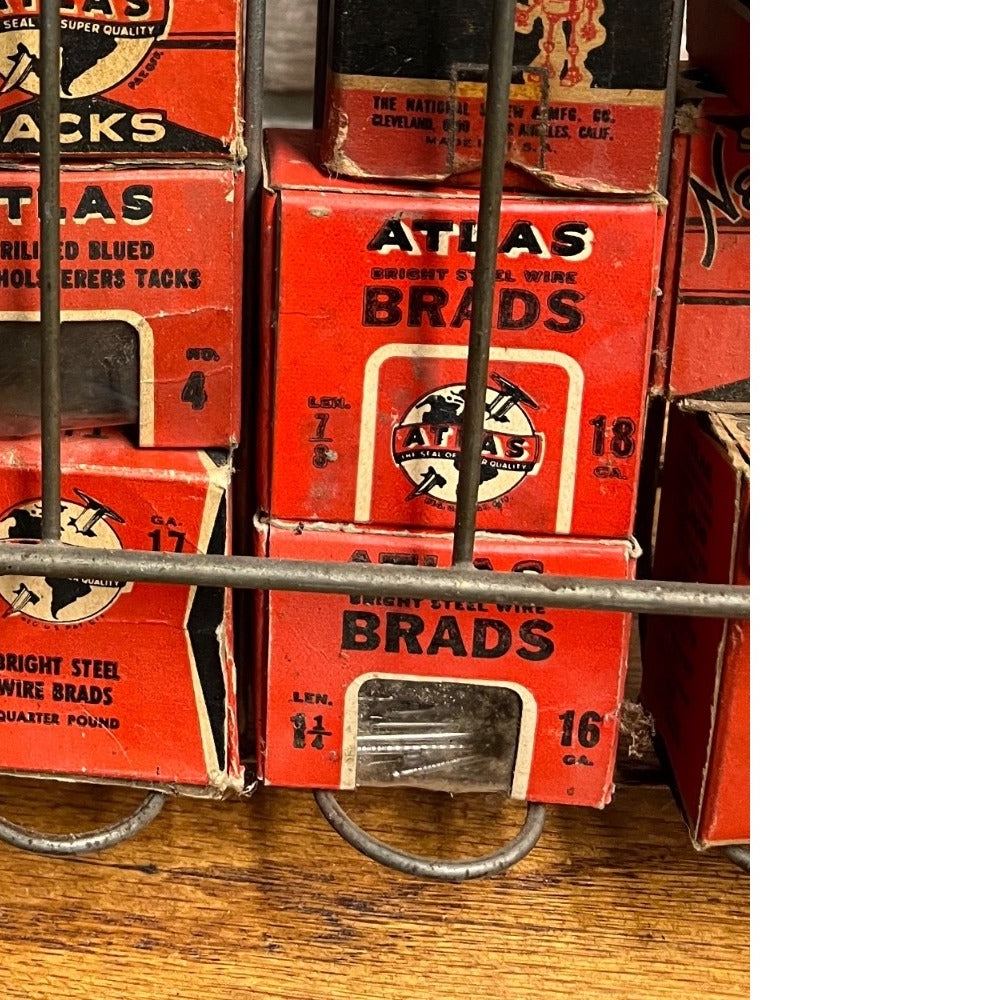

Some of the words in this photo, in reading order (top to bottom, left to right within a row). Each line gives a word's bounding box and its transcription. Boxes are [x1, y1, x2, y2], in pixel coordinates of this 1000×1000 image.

[3, 18, 36, 30] SEAL
[60, 18, 100, 35] SUPER
[103, 24, 156, 36] QUALITY
[88, 240, 155, 261] BLUED
[134, 268, 202, 290] TACKS
[370, 267, 449, 281] BRIGHT
[523, 269, 578, 284] WIRE
[181, 370, 208, 411] 4
[403, 426, 530, 462] ATAS
[587, 414, 636, 459] 18
[489, 460, 527, 471] QUALITY
[150, 515, 183, 527] GA.
[147, 529, 187, 553] 17
[340, 610, 556, 662] BRADS
[70, 658, 122, 682] STEEL
[51, 682, 114, 706] BRADS
[291, 690, 333, 706] LEN.
[67, 713, 121, 731] POUND
[558, 708, 604, 749] 16
